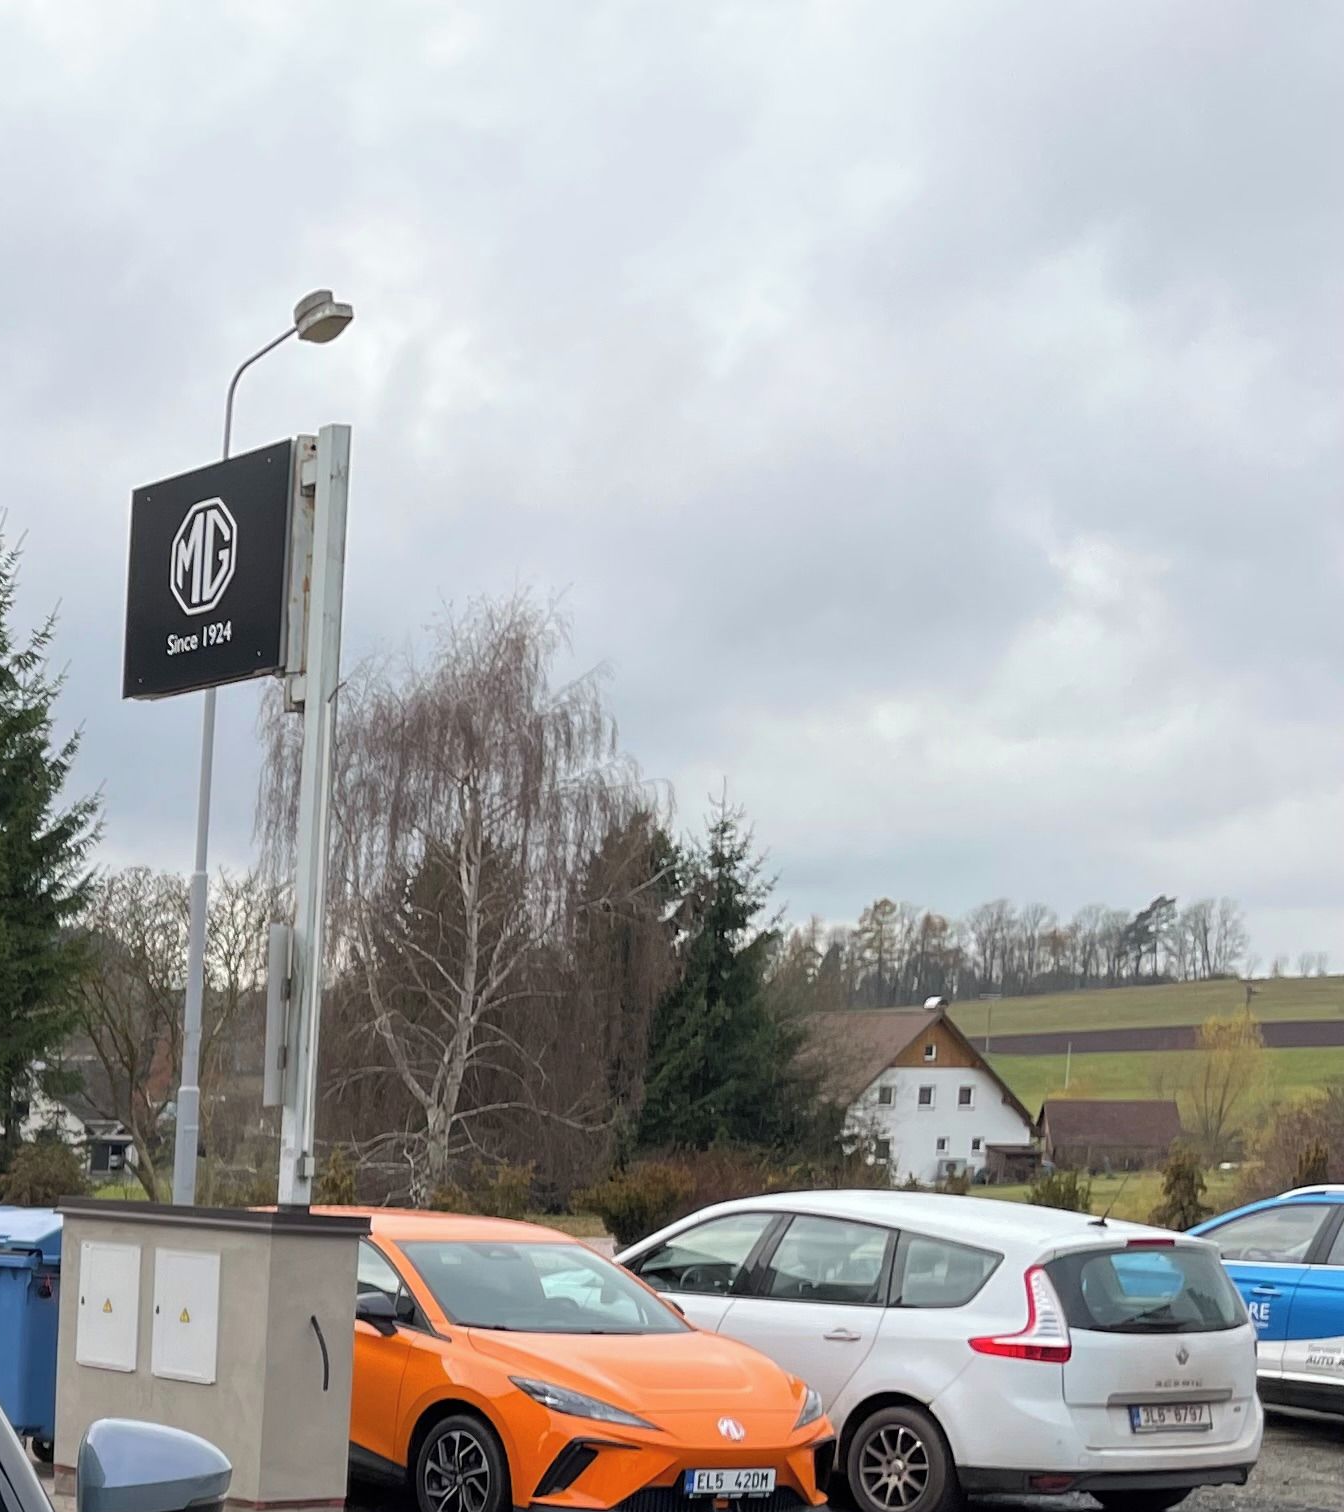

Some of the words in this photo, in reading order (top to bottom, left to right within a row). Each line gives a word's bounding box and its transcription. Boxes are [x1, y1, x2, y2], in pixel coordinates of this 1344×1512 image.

[177, 509, 230, 604] MG
[167, 632, 198, 655] Since
[202, 621, 232, 647] 1924
[697, 1472, 724, 1490] EL5
